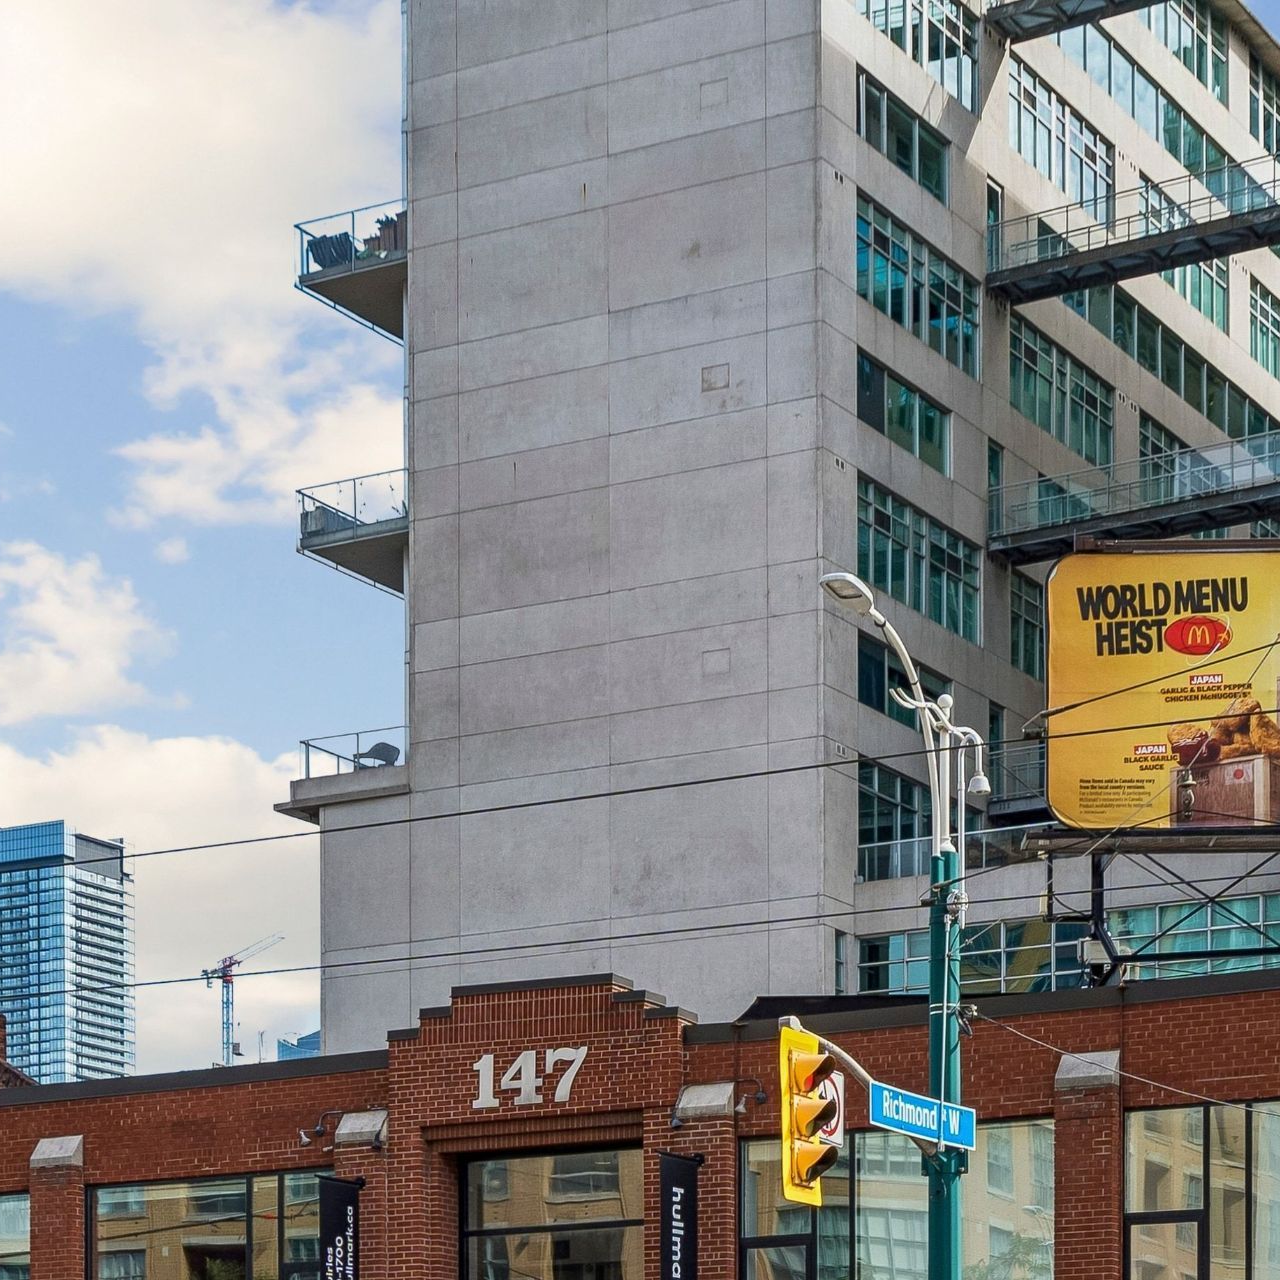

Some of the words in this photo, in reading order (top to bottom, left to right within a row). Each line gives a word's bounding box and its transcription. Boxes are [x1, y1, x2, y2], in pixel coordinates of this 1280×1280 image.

[1076, 582, 1171, 621] WORLD
[1173, 576, 1249, 615] MENU
[1095, 618, 1168, 657] HEIST
[1190, 674, 1222, 685] JAPAN
[1160, 687, 1189, 695] GARLIC
[1196, 684, 1223, 692] BLACK
[1223, 682, 1253, 691] PEPPER
[1164, 694, 1199, 703] CHICKEN
[1135, 745, 1166, 754] JAPAN
[1123, 756, 1149, 764] BLACK
[1150, 754, 1179, 763] GARLIC
[1139, 763, 1165, 771] SAUCE
[472, 1045, 588, 1109] 147
[882, 1090, 938, 1131] Richmond
[949, 1108, 960, 1136] W
